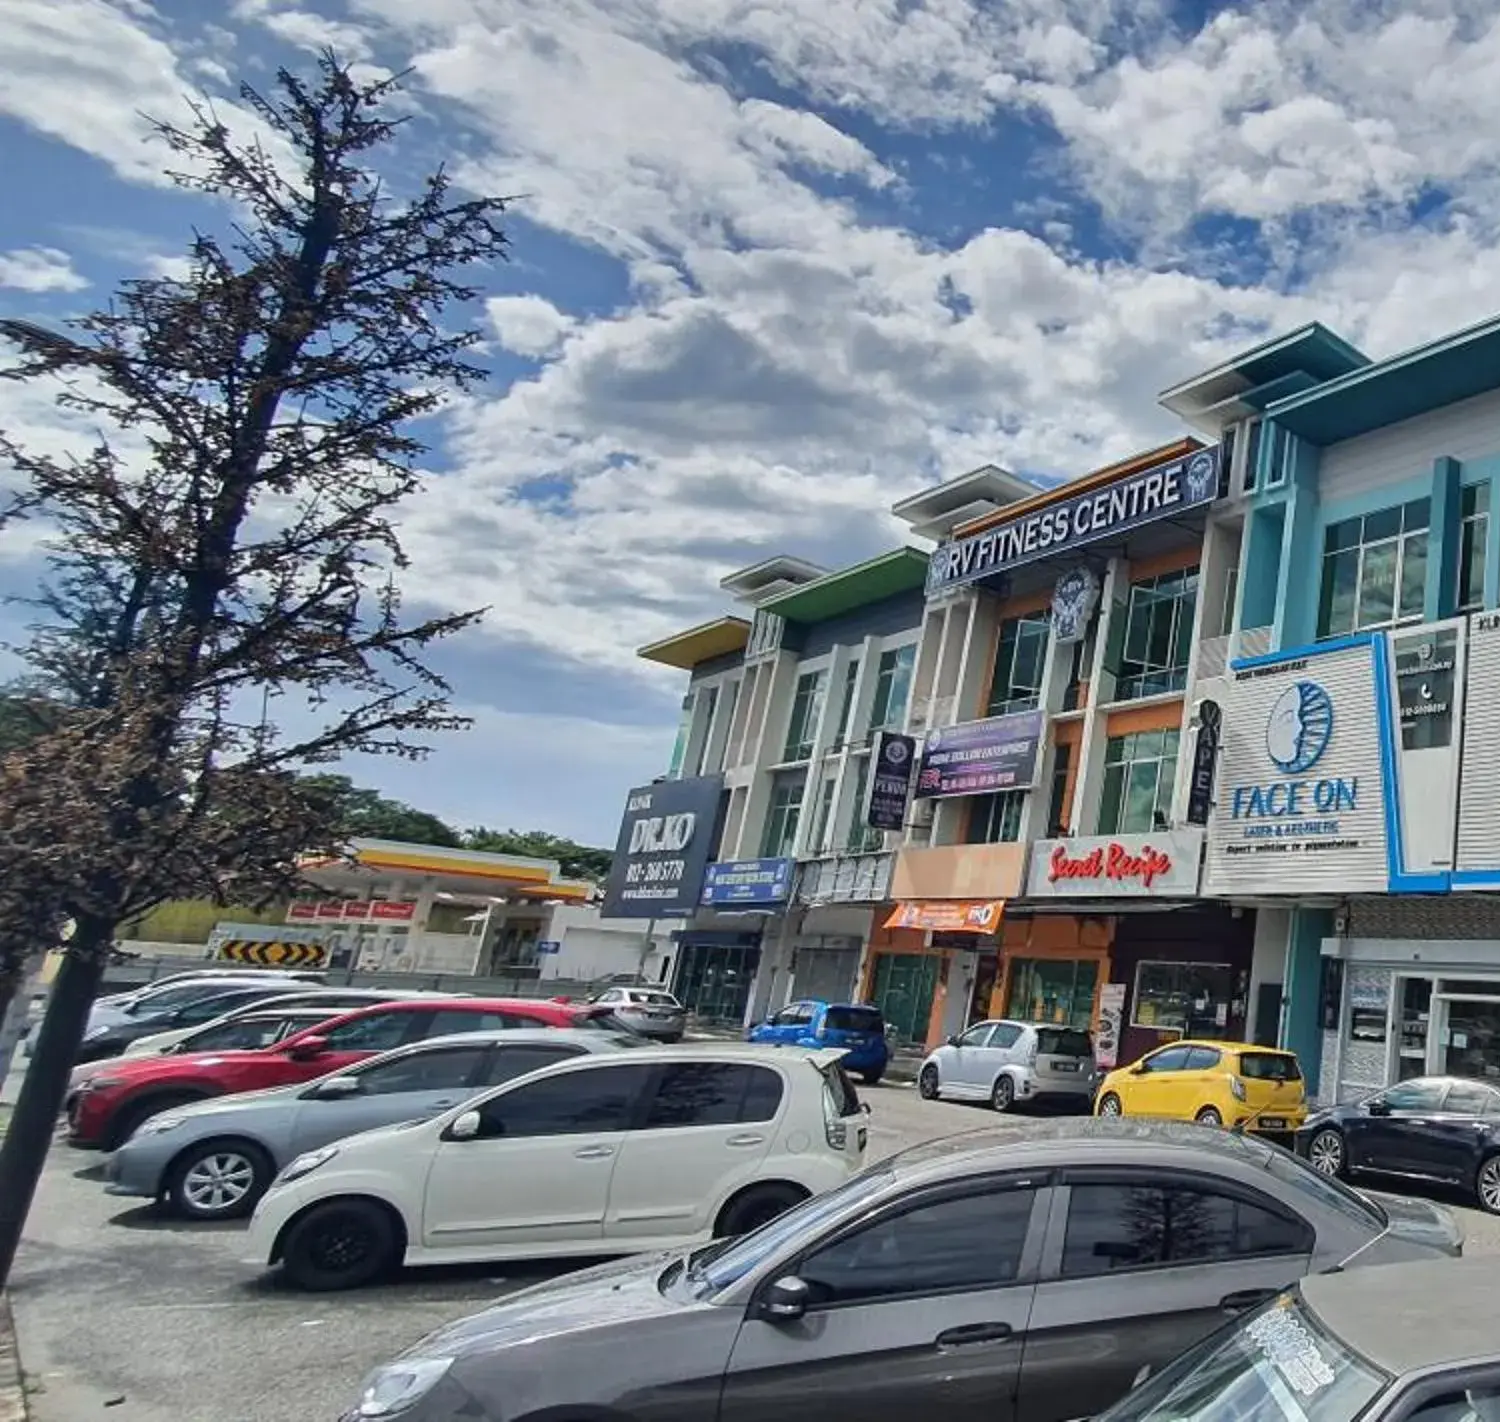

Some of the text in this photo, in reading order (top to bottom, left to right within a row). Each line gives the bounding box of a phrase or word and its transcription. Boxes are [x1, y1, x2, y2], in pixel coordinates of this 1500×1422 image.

[946, 464, 1184, 579] RV FITNESS CENTRE
[1231, 780, 1304, 819] FACE
[1313, 777, 1358, 813] ON
[1048, 843, 1172, 887] Secret Recipe
